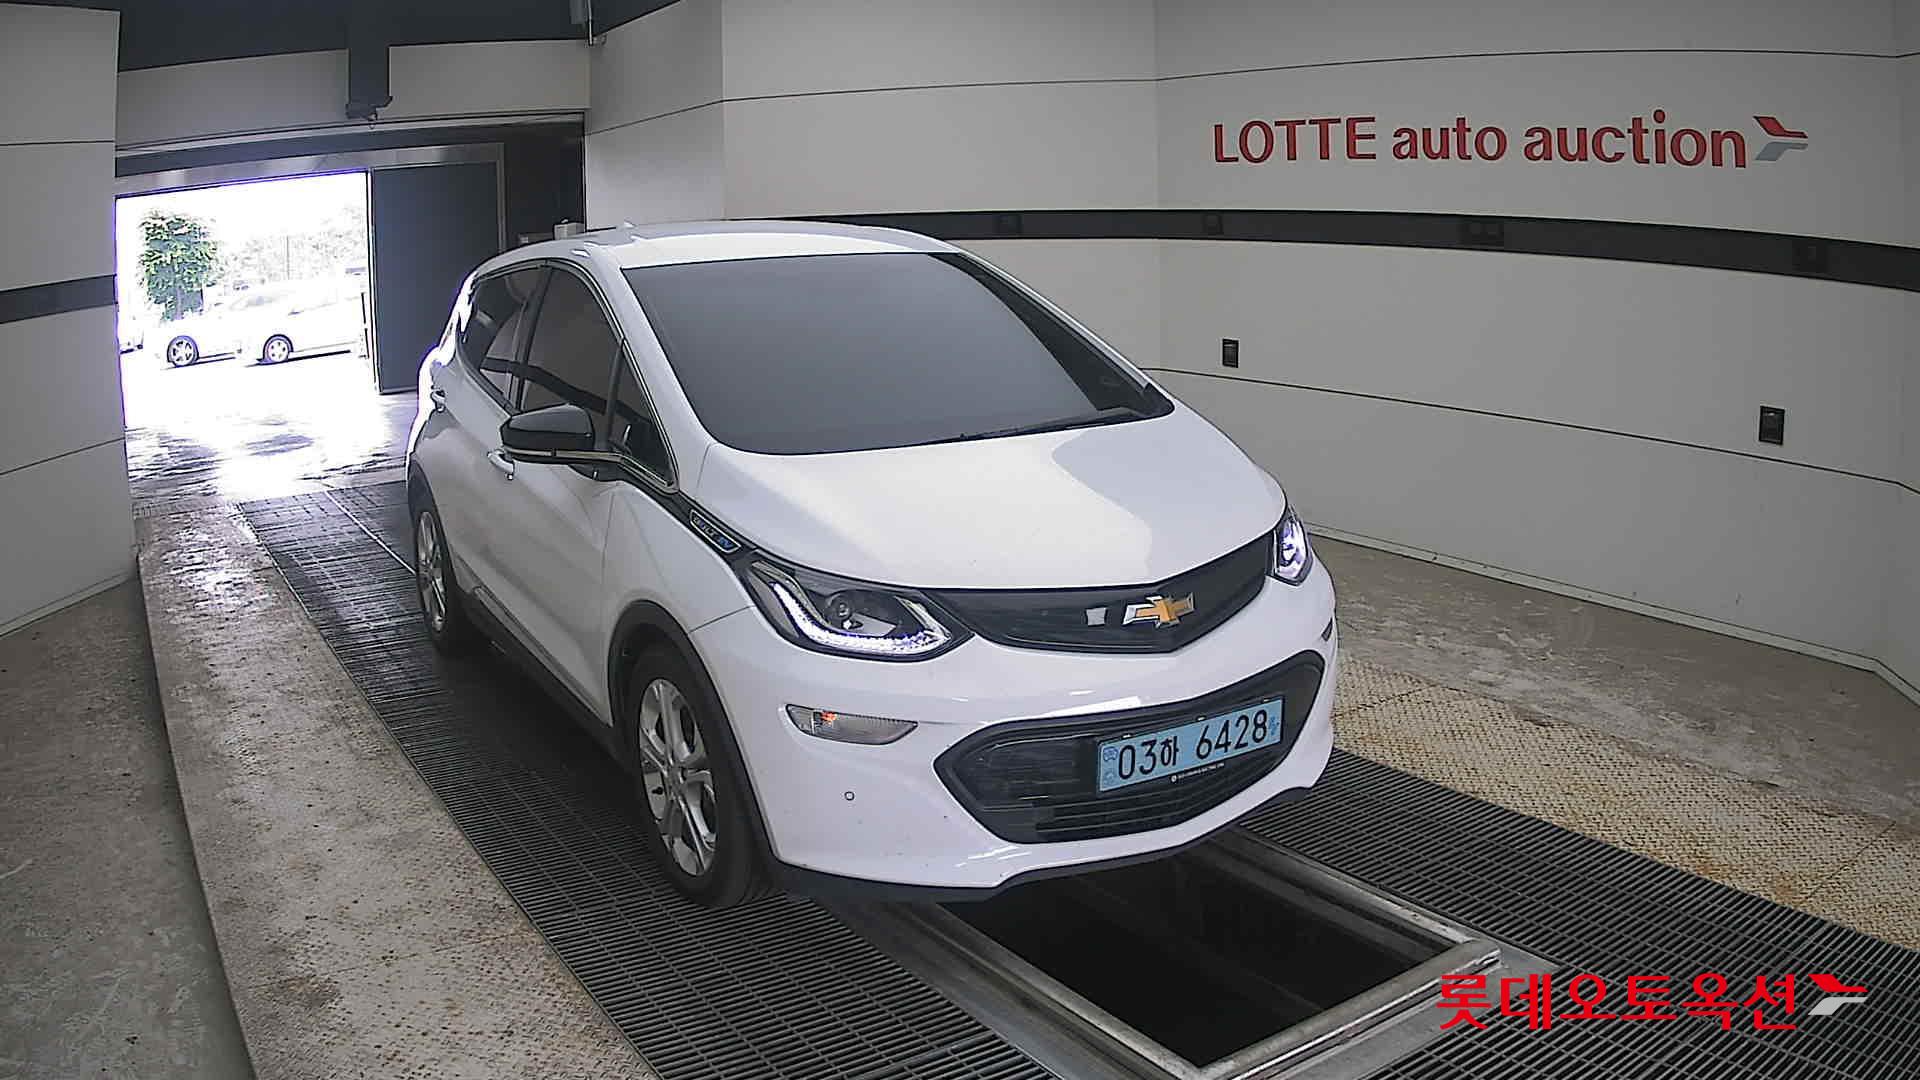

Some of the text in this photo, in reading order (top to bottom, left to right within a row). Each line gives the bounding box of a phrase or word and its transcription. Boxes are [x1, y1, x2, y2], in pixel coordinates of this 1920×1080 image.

[1213, 109, 1747, 169] LOTTE auto auction
[1118, 735, 1180, 780] 03하
[1196, 709, 1268, 760] 6428
